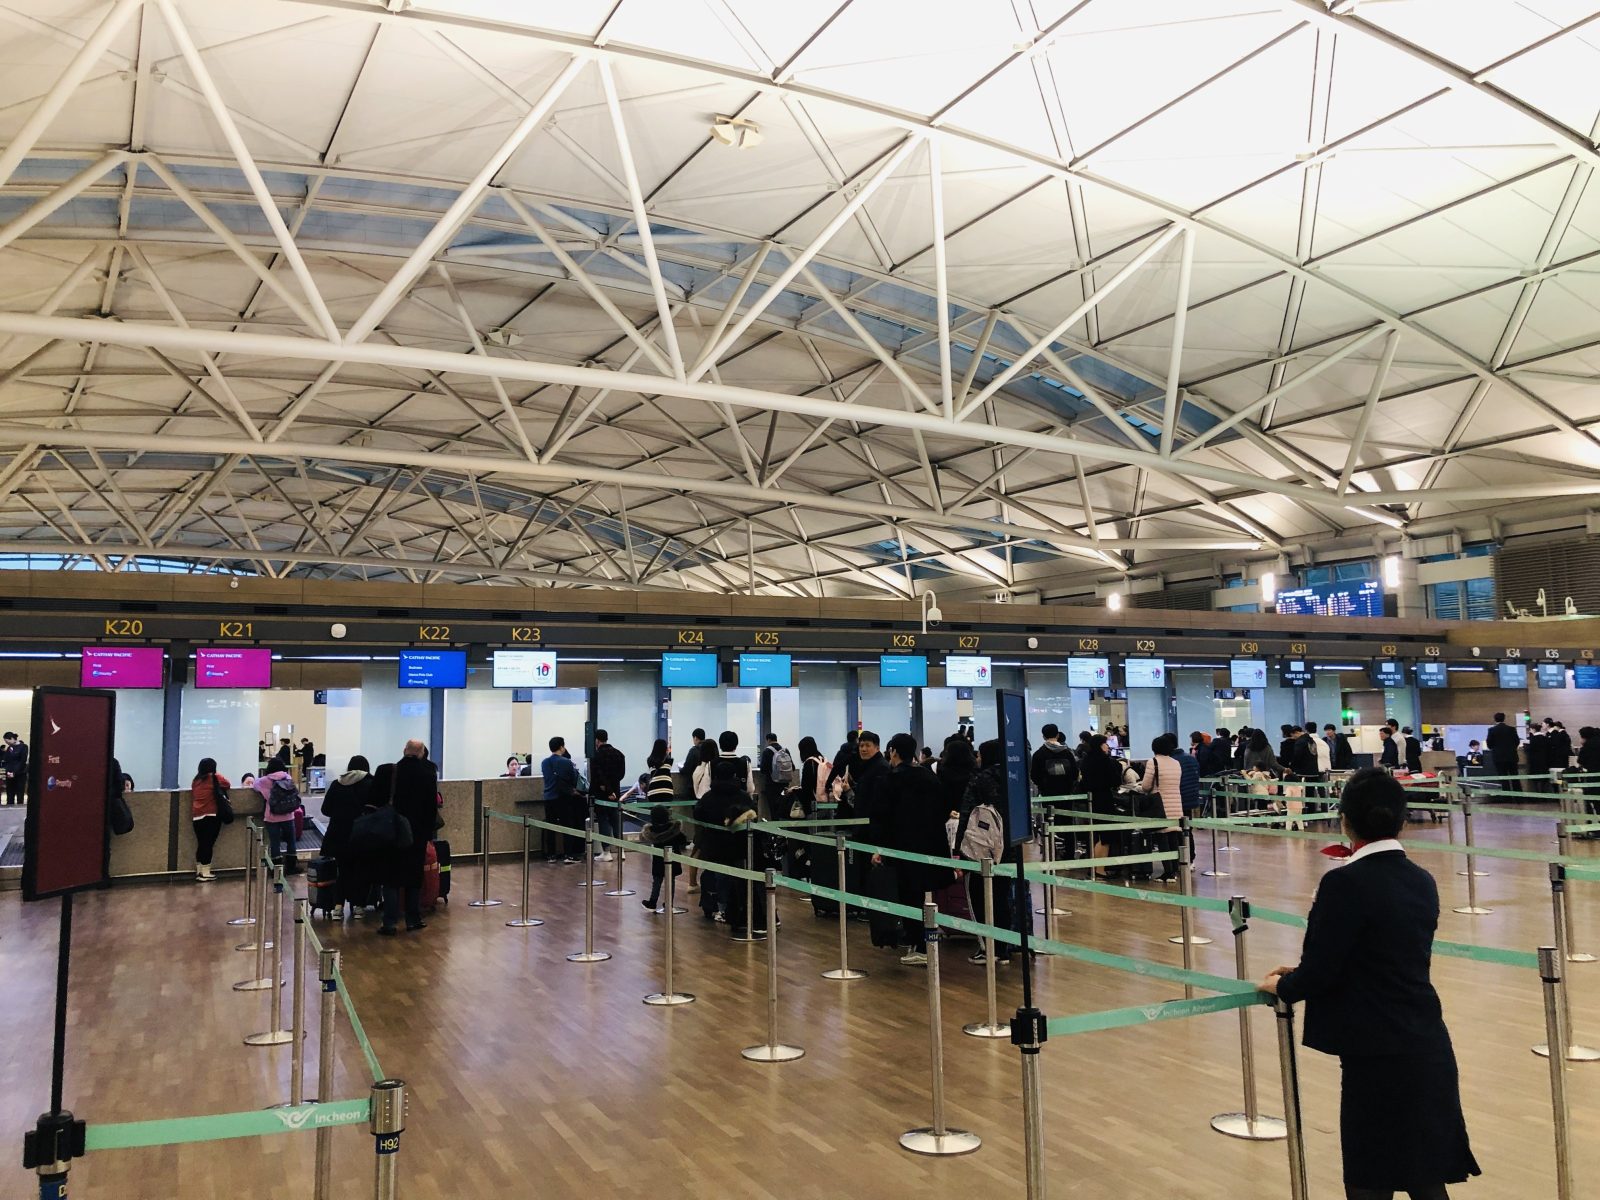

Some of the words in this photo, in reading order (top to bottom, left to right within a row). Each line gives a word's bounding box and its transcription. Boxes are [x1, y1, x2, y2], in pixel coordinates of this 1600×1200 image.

[106, 620, 143, 636] K20
[220, 623, 253, 637] K21
[419, 626, 450, 640] K22
[512, 628, 541, 641] K23
[678, 631, 704, 644] K24
[755, 632, 779, 644] K25
[893, 635, 915, 647] K26
[959, 636, 980, 648] K27
[1079, 639, 1099, 650] K28
[1136, 640, 1155, 651] K29
[1241, 642, 1258, 653] K30
[1291, 644, 1306, 654] K31
[1382, 645, 1397, 656] K32
[1424, 647, 1440, 656] K33
[536, 666, 549, 676] 10
[977, 668, 986, 678] 10
[315, 1110, 360, 1123] Incheon
[380, 1136, 399, 1151] H92
